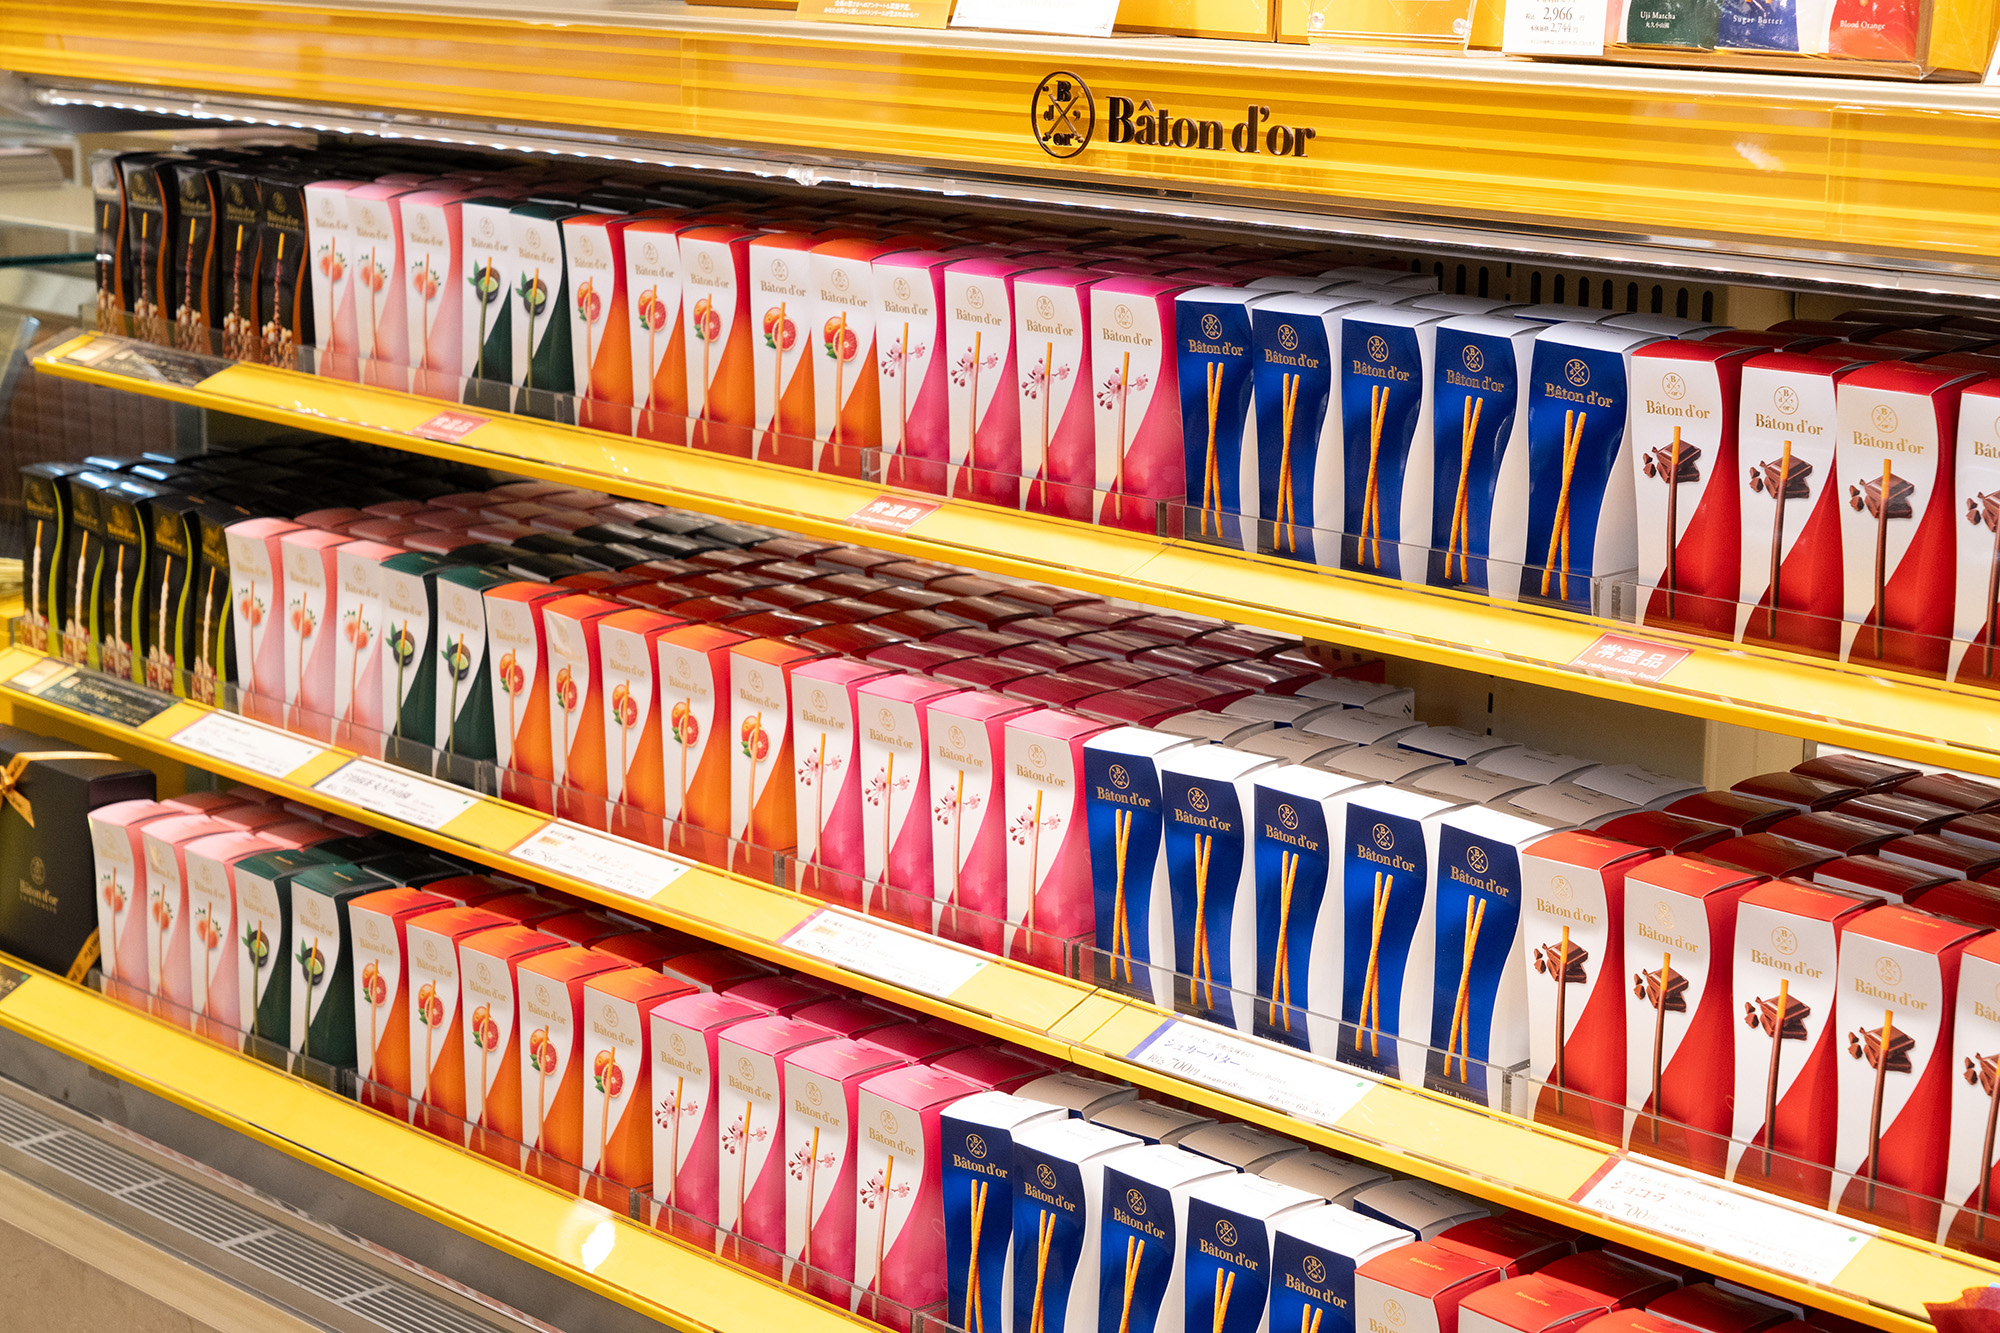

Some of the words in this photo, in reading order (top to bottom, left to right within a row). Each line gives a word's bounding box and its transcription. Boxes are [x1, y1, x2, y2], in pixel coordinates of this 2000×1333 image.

[1543, 6, 1573, 21] 2,966
[1640, 11, 1651, 20] Uji
[1652, 11, 1676, 20] Matcha
[1733, 14, 1755, 25] Sugar
[1758, 16, 1783, 25] Butter
[1550, 22, 1572, 32] 2,744
[1840, 20, 1858, 28] Blood
[1860, 21, 1886, 30] Orange
[1107, 95, 1224, 150] Bâton
[1188, 339, 1220, 354] Bâton
[1264, 349, 1297, 366] Bâton
[1353, 361, 1387, 377] Bâton
[1446, 370, 1482, 388] Bâton
[1545, 383, 1586, 402] Bâton
[1646, 400, 1684, 416] Bâton
[1755, 414, 1795, 431] Bâton
[1852, 430, 1895, 450] Bâton
[1974, 440, 2000, 458] Bât
[867, 501, 921, 520] 常温品
[1595, 643, 1666, 670] 常温品
[1576, 659, 1586, 667] No
[1586, 662, 1637, 677] refrigeration
[1638, 670, 1658, 681] food
[802, 710, 828, 726] Bâton
[870, 728, 894, 745] Bâton
[939, 746, 965, 763] Bâton
[1016, 764, 1045, 783] Bâton
[1096, 786, 1130, 804] Bâton
[1174, 808, 1208, 827] Bâton
[1266, 824, 1298, 846] Bâton
[1357, 844, 1392, 866] Bâton
[1450, 866, 1486, 889] Bâton
[1536, 898, 1572, 919] Bâton
[1638, 922, 1674, 944] Bâton
[1751, 949, 1790, 972] Bâton
[1854, 977, 1895, 1002] Bâton
[1147, 1054, 1166, 1065] 税込
[1164, 1038, 1240, 1066] シュガーバター
[1346, 1058, 1366, 1071] Sugar
[729, 1075, 754, 1094] Bâton
[1434, 1084, 1452, 1096] Sugar
[795, 1099, 822, 1120] Bâton
[869, 1128, 896, 1149] Bâton
[953, 1154, 986, 1174] Bâton
[1024, 1182, 1055, 1205] Bâton
[1611, 1180, 1666, 1202] ショコラ
[1114, 1207, 1144, 1231] Bâton
[1200, 1238, 1235, 1262] Bâton
[1285, 1273, 1322, 1298] Bâton
